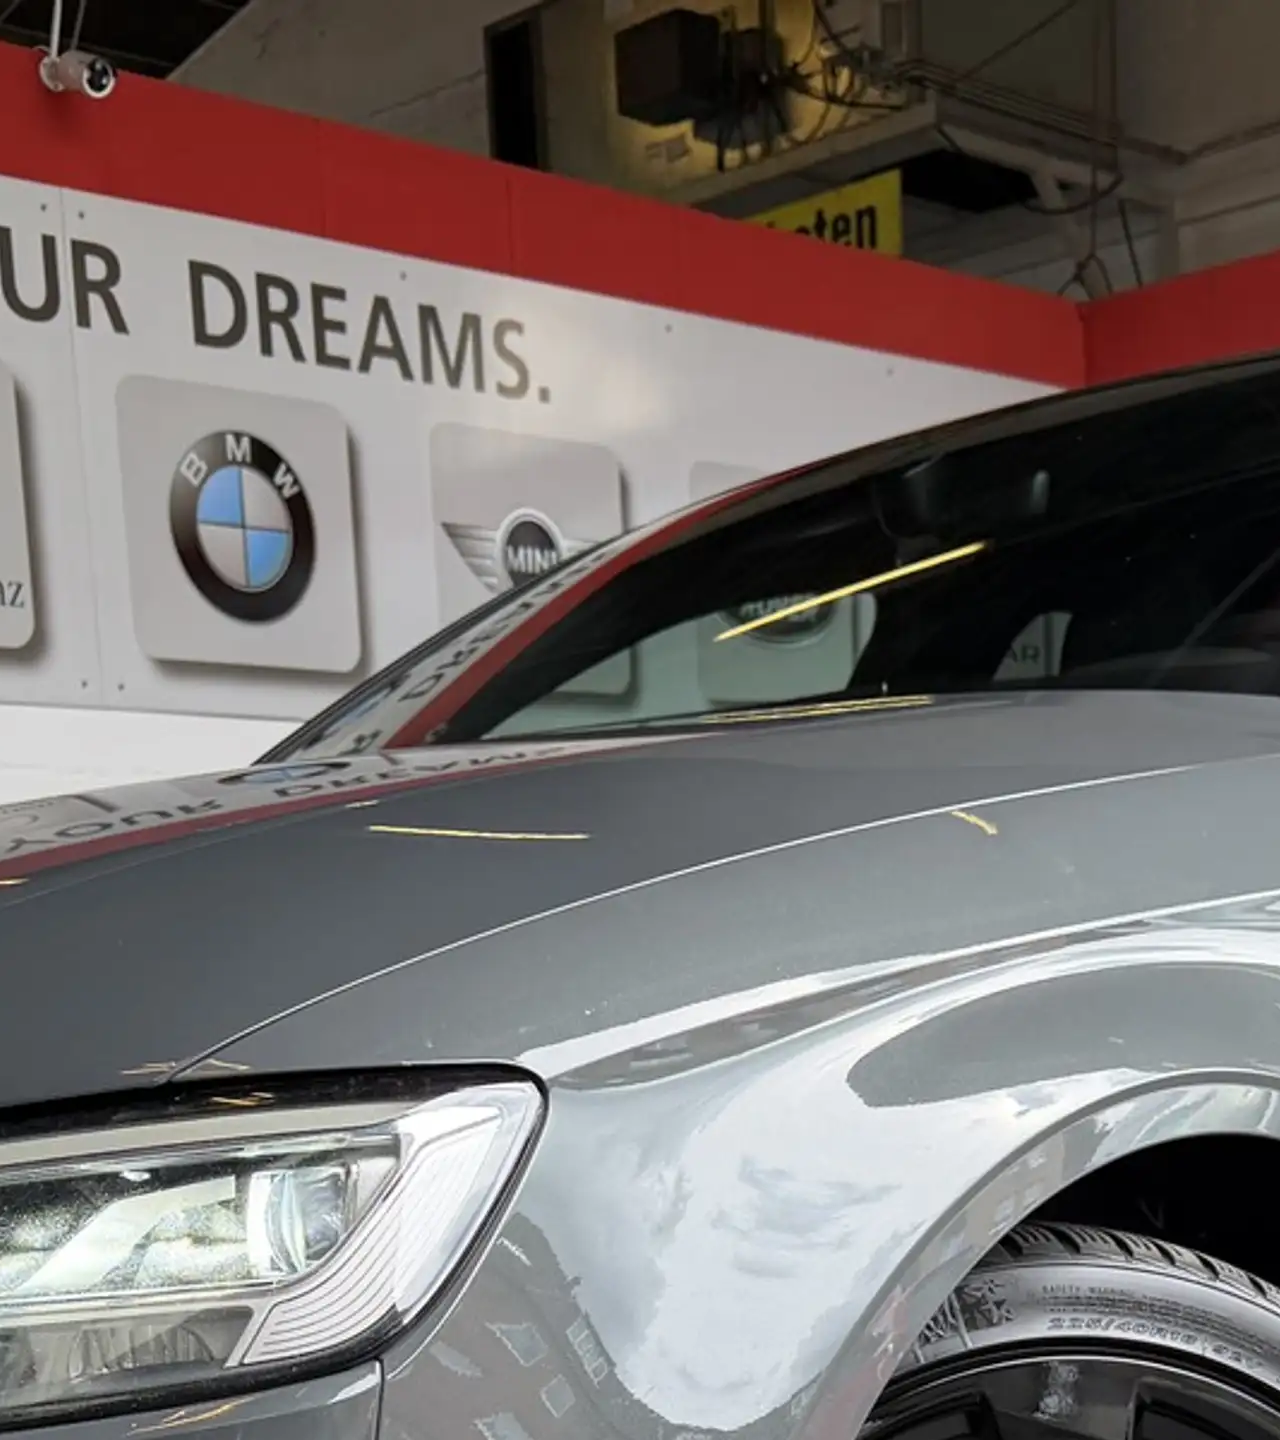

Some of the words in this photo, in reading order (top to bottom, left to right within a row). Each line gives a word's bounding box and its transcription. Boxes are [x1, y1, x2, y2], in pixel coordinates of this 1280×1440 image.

[794, 205, 877, 250] ten
[187, 259, 551, 404] DREAMS.
[180, 433, 299, 499] BMW
